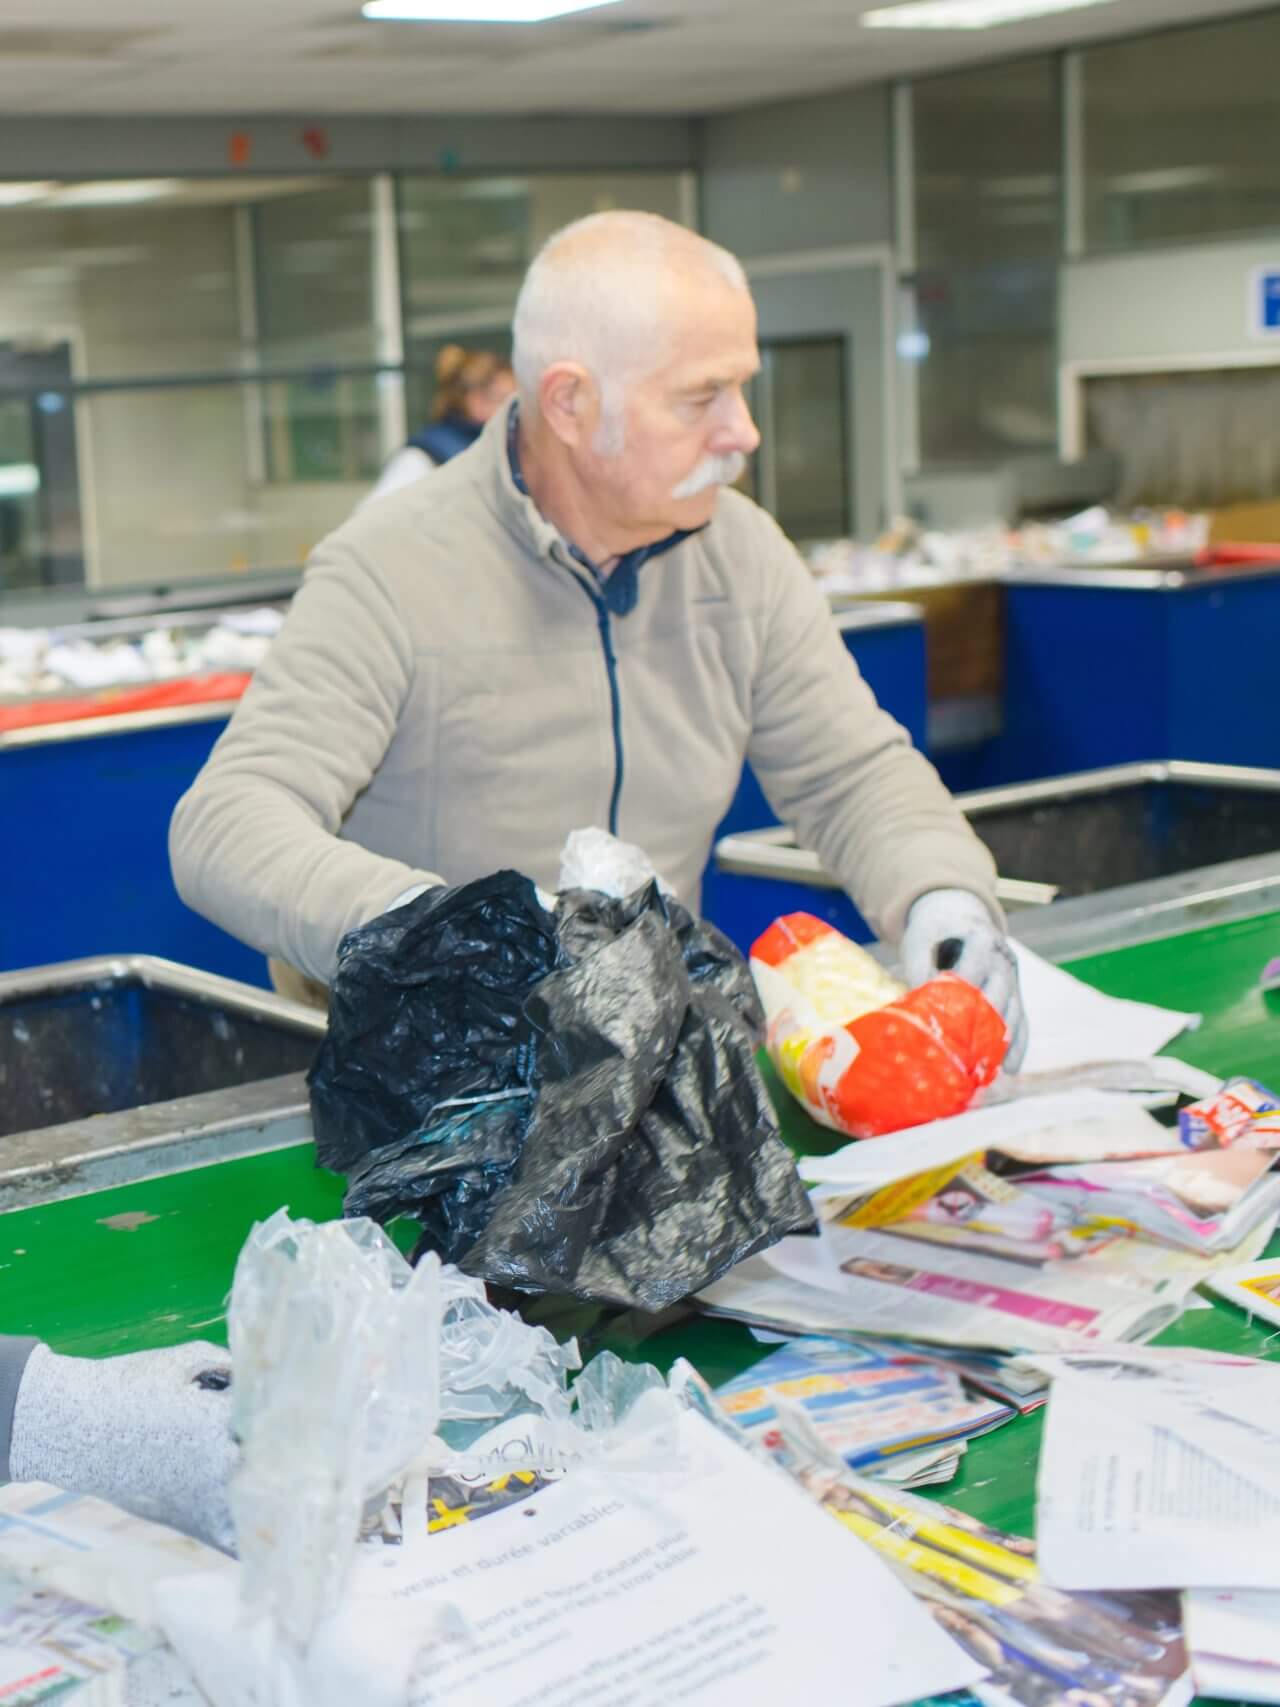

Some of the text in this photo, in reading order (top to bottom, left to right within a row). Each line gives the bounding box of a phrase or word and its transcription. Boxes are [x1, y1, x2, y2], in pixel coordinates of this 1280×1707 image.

[452, 1561, 473, 1579] et
[476, 1540, 535, 1571] durée
[537, 1497, 625, 1548] variables
